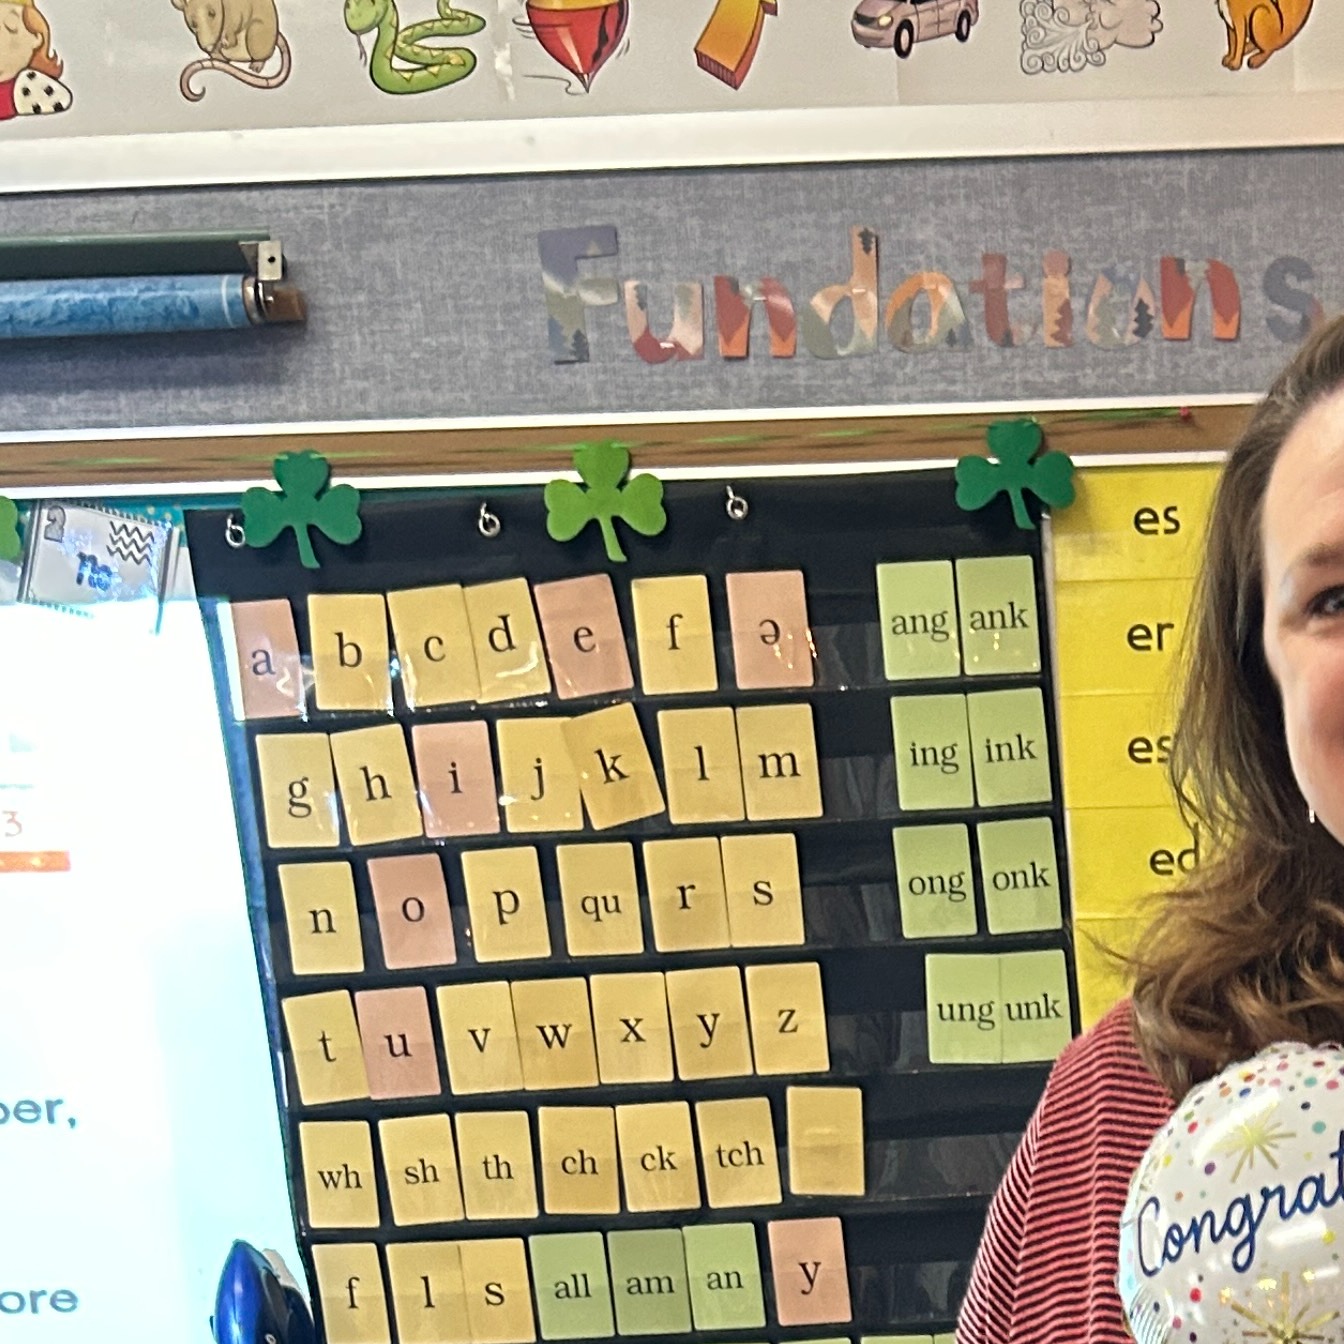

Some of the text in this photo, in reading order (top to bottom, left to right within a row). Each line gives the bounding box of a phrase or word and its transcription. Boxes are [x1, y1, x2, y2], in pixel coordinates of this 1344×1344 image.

[1133, 505, 1181, 536] es
[891, 601, 1029, 642] ang ank
[1126, 622, 1175, 651] er
[251, 649, 275, 676] a
[334, 631, 362, 668] b
[423, 636, 445, 662] c
[488, 614, 516, 653] d
[573, 626, 596, 653] e
[667, 613, 683, 651] f
[909, 733, 1037, 775] ing ink
[288, 776, 312, 819] g
[359, 765, 392, 802] h
[448, 761, 462, 794] i
[530, 757, 545, 801] j
[594, 748, 629, 784] k
[758, 752, 801, 779] m
[908, 861, 1050, 902] ong onk
[308, 880, 774, 934] n o p qu r s
[937, 992, 1062, 1030] ung unk
[318, 1009, 798, 1063] t u v w x y z
[317, 1140, 765, 1190] wh sh th ch ck tch
[347, 1276, 360, 1309] f
[484, 1282, 505, 1306] s
[554, 1273, 592, 1300] all
[626, 1275, 675, 1295] am
[707, 1271, 744, 1290] an
[798, 1261, 821, 1296] y
